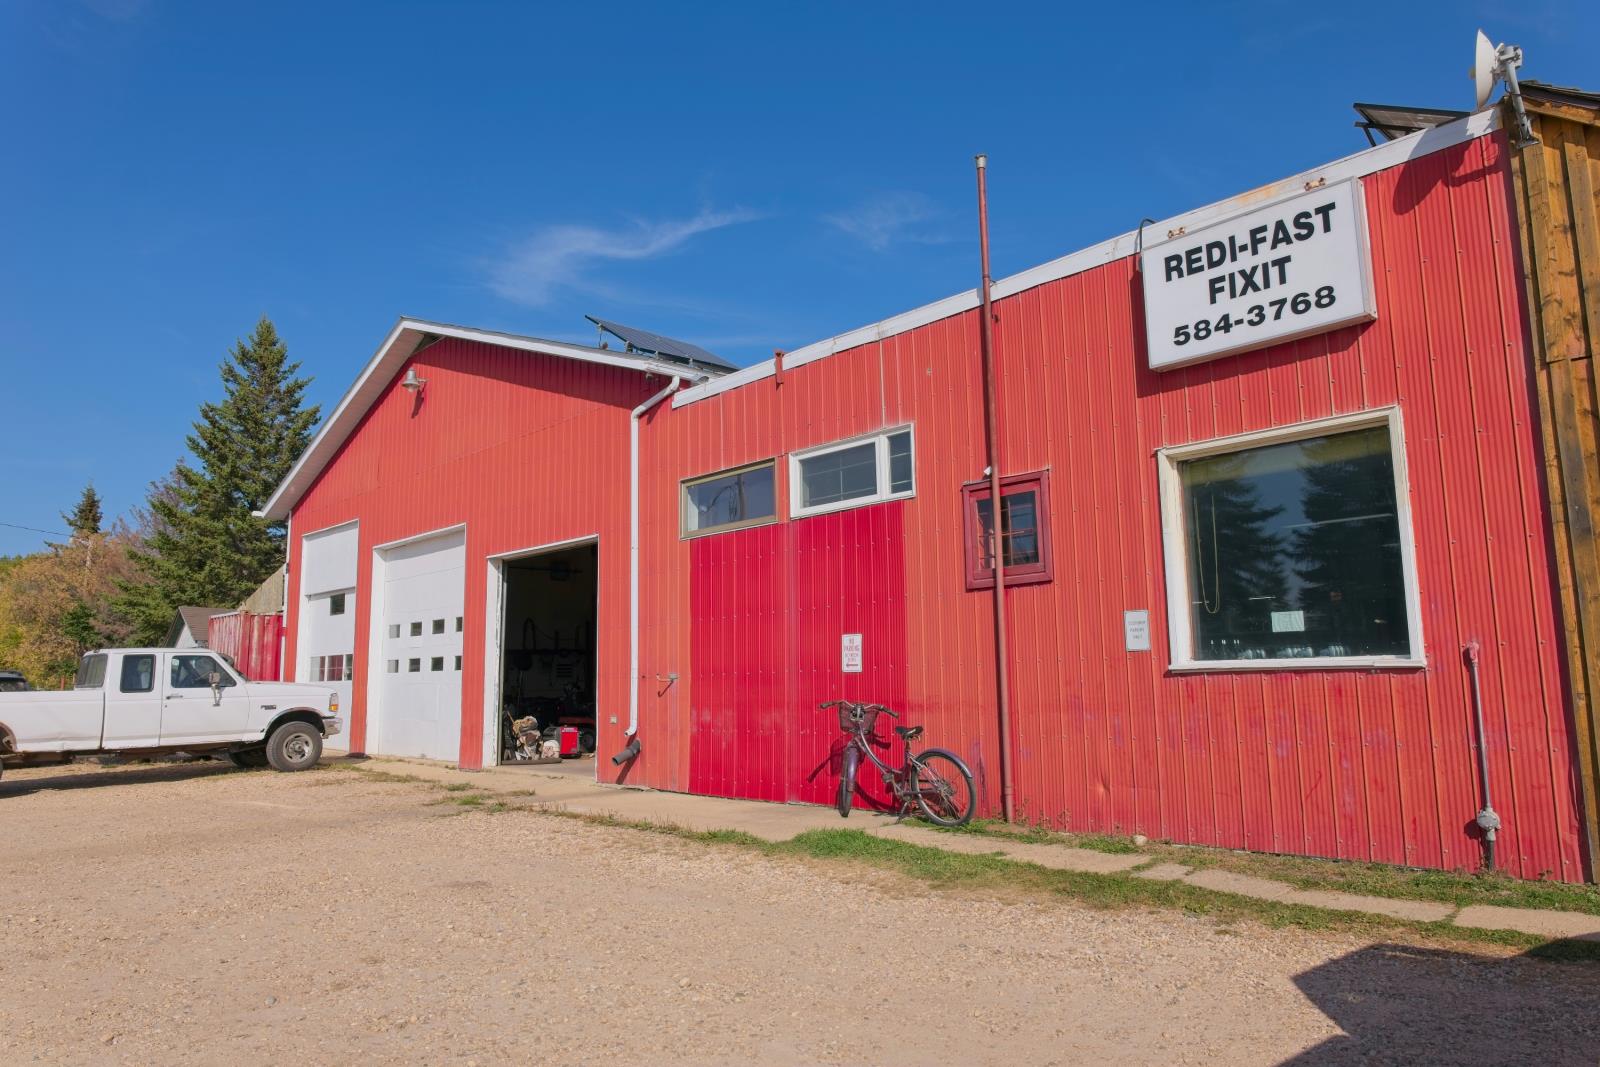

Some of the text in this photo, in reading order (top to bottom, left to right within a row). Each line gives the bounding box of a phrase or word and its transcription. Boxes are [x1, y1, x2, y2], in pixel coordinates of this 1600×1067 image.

[1164, 202, 1336, 283] REDI-FAST
[1208, 255, 1292, 306] FIXIT
[1173, 286, 1336, 346] 584-3768
